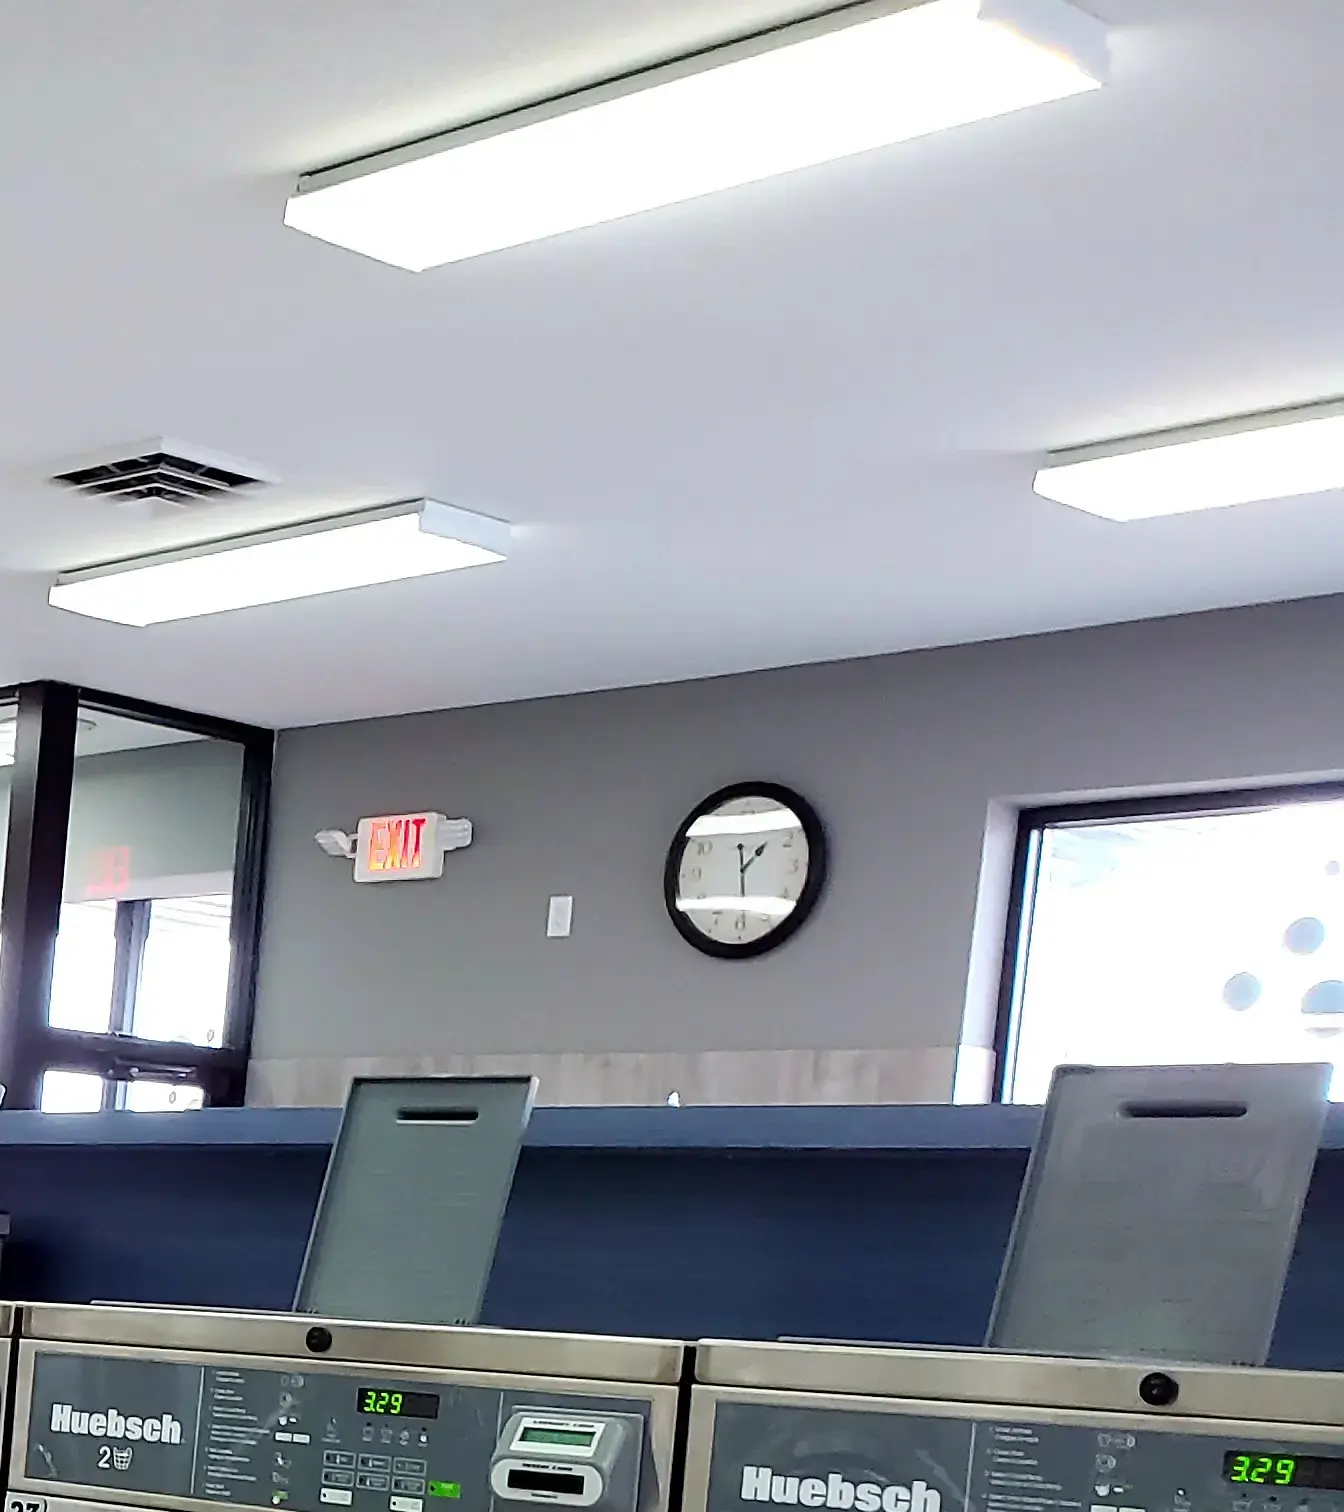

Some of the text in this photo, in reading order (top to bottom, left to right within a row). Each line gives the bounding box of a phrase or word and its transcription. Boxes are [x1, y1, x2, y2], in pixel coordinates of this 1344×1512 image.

[370, 819, 426, 870] EXIT
[50, 1403, 182, 1444] Huebsch
[97, 1446, 111, 1468] 2
